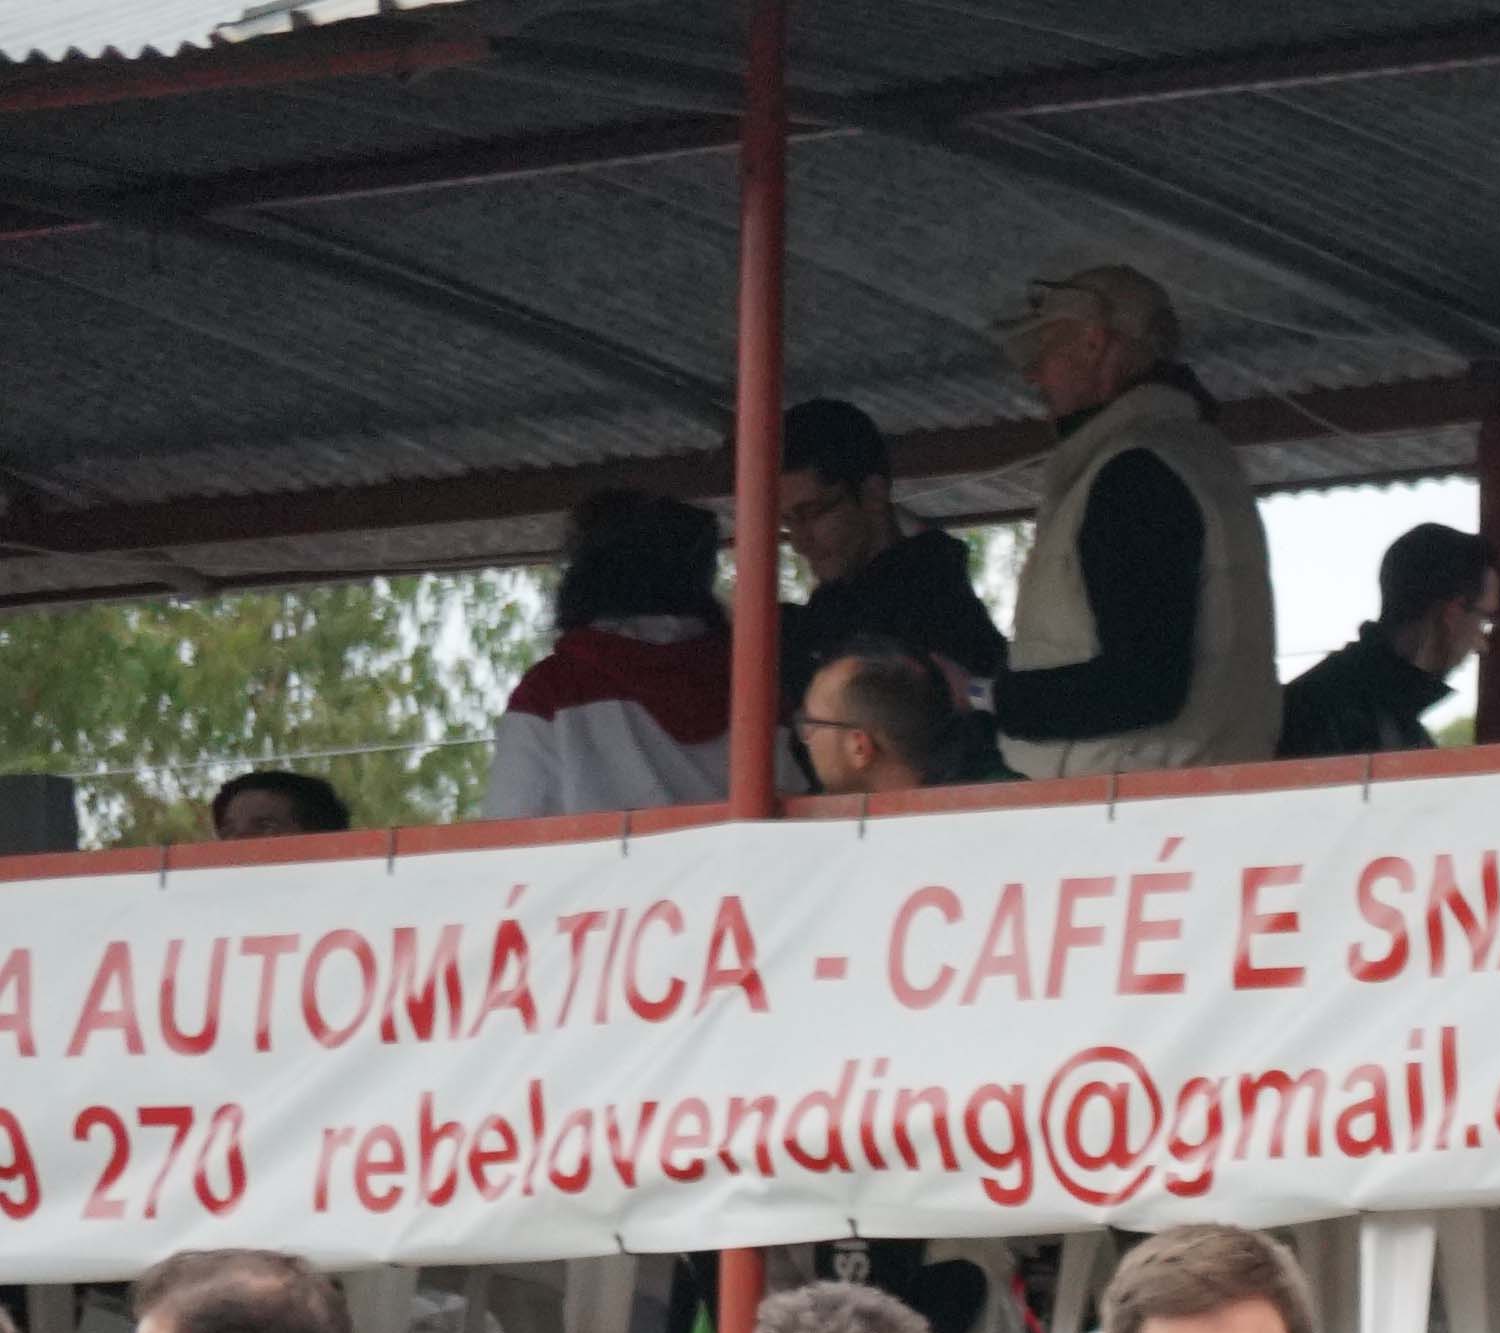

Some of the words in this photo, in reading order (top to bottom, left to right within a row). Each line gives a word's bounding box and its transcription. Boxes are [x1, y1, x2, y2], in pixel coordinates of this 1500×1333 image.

[64, 883, 769, 1058] AUTOMÁTICA
[888, 836, 1192, 1010] CAFÉ
[1232, 865, 1306, 991] E
[72, 1103, 248, 1220] 270
